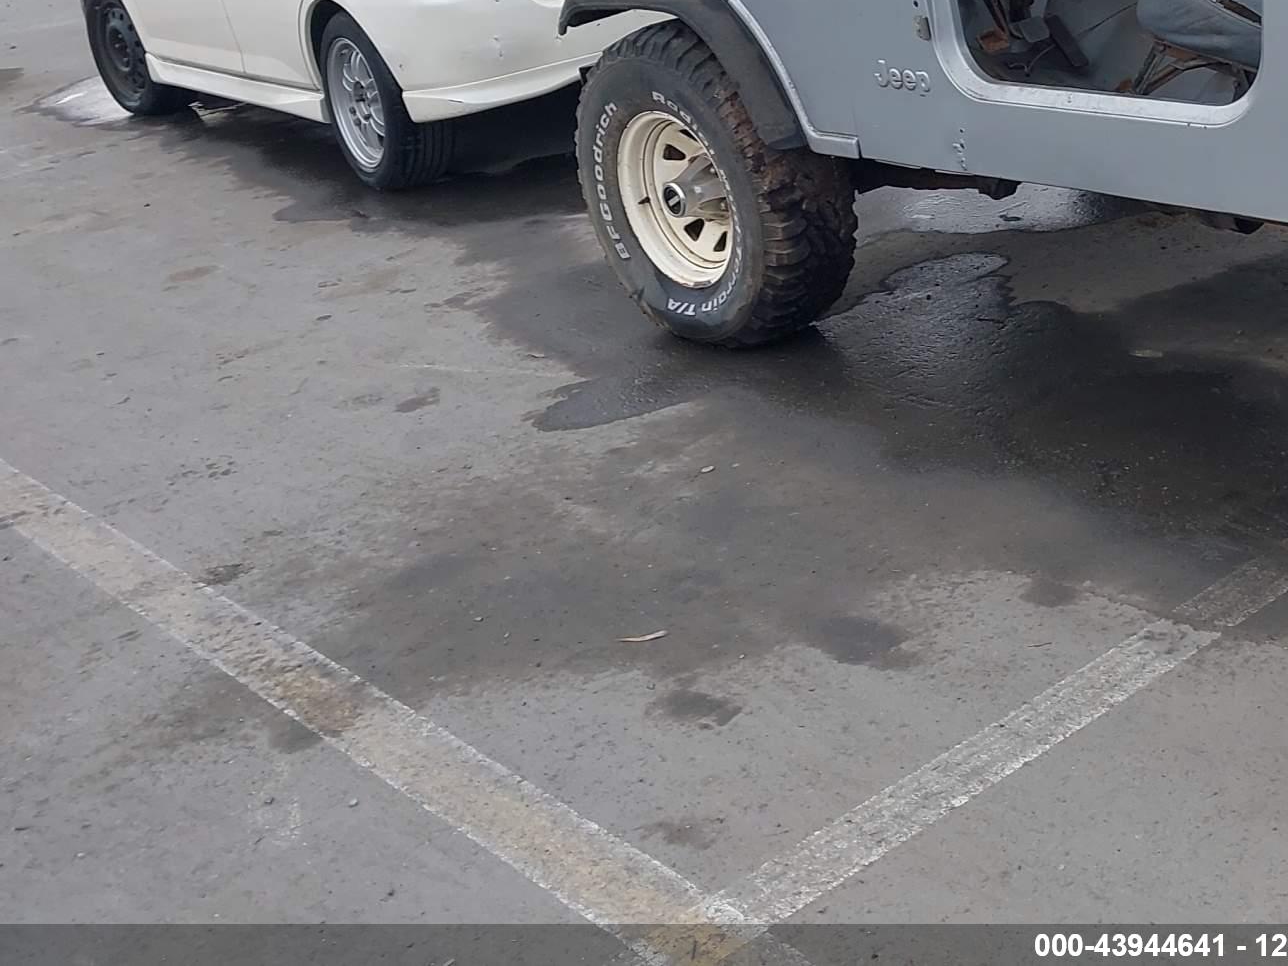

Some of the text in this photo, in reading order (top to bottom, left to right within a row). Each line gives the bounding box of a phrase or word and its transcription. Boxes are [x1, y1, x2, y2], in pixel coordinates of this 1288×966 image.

[873, 59, 931, 98] Jeep
[593, 101, 632, 260] BFGoodrich
[666, 296, 698, 317] T/A
